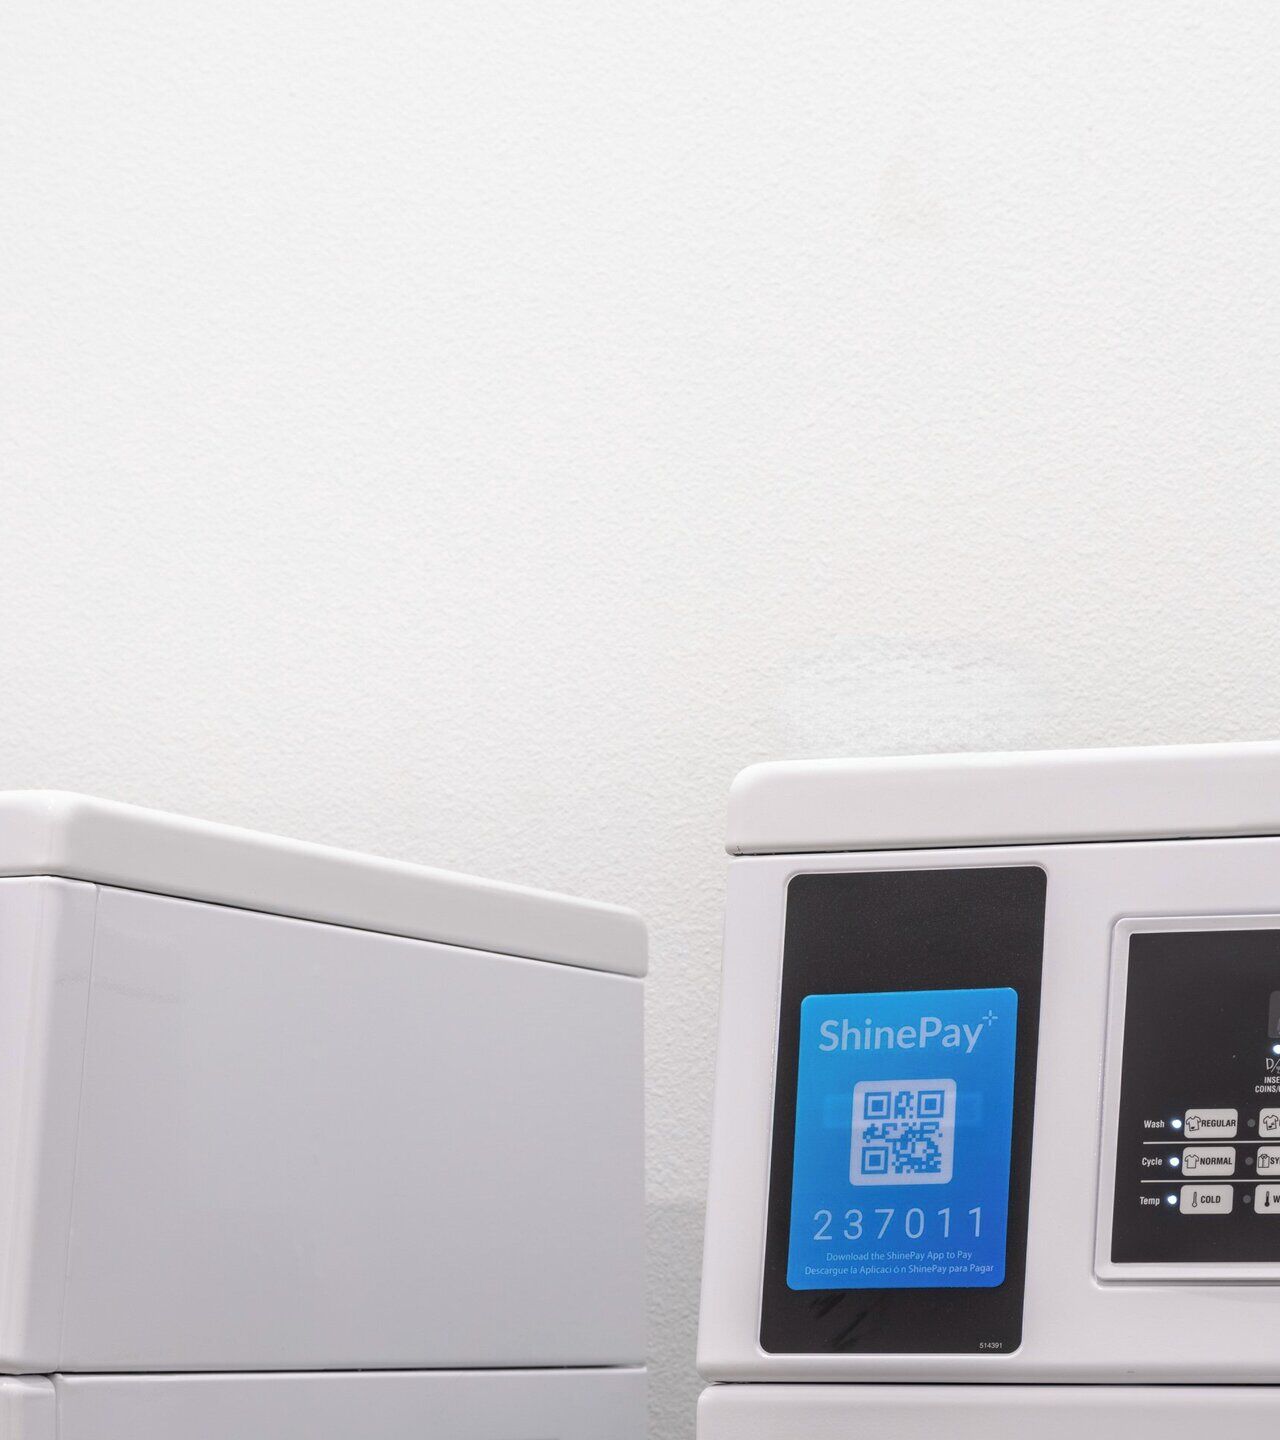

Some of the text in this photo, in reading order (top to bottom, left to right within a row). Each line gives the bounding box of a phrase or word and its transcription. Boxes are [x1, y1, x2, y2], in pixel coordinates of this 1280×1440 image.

[818, 1016, 984, 1053] ShinePay
[1143, 1119, 1165, 1129] Wash
[1200, 1118, 1237, 1128] REGULAR
[1141, 1156, 1163, 1167] Cycle
[1199, 1156, 1233, 1166] NORMAL
[1139, 1196, 1161, 1207] Temp
[1199, 1194, 1222, 1204] COLD
[813, 1206, 983, 1241] 237011
[826, 1250, 973, 1262] Download the ShinePay App to Pay
[804, 1265, 848, 1277] Descargue
[850, 1265, 858, 1275] la
[908, 1263, 947, 1276] ShinePay
[948, 1265, 968, 1276] para
[969, 1263, 995, 1274] Pagar
